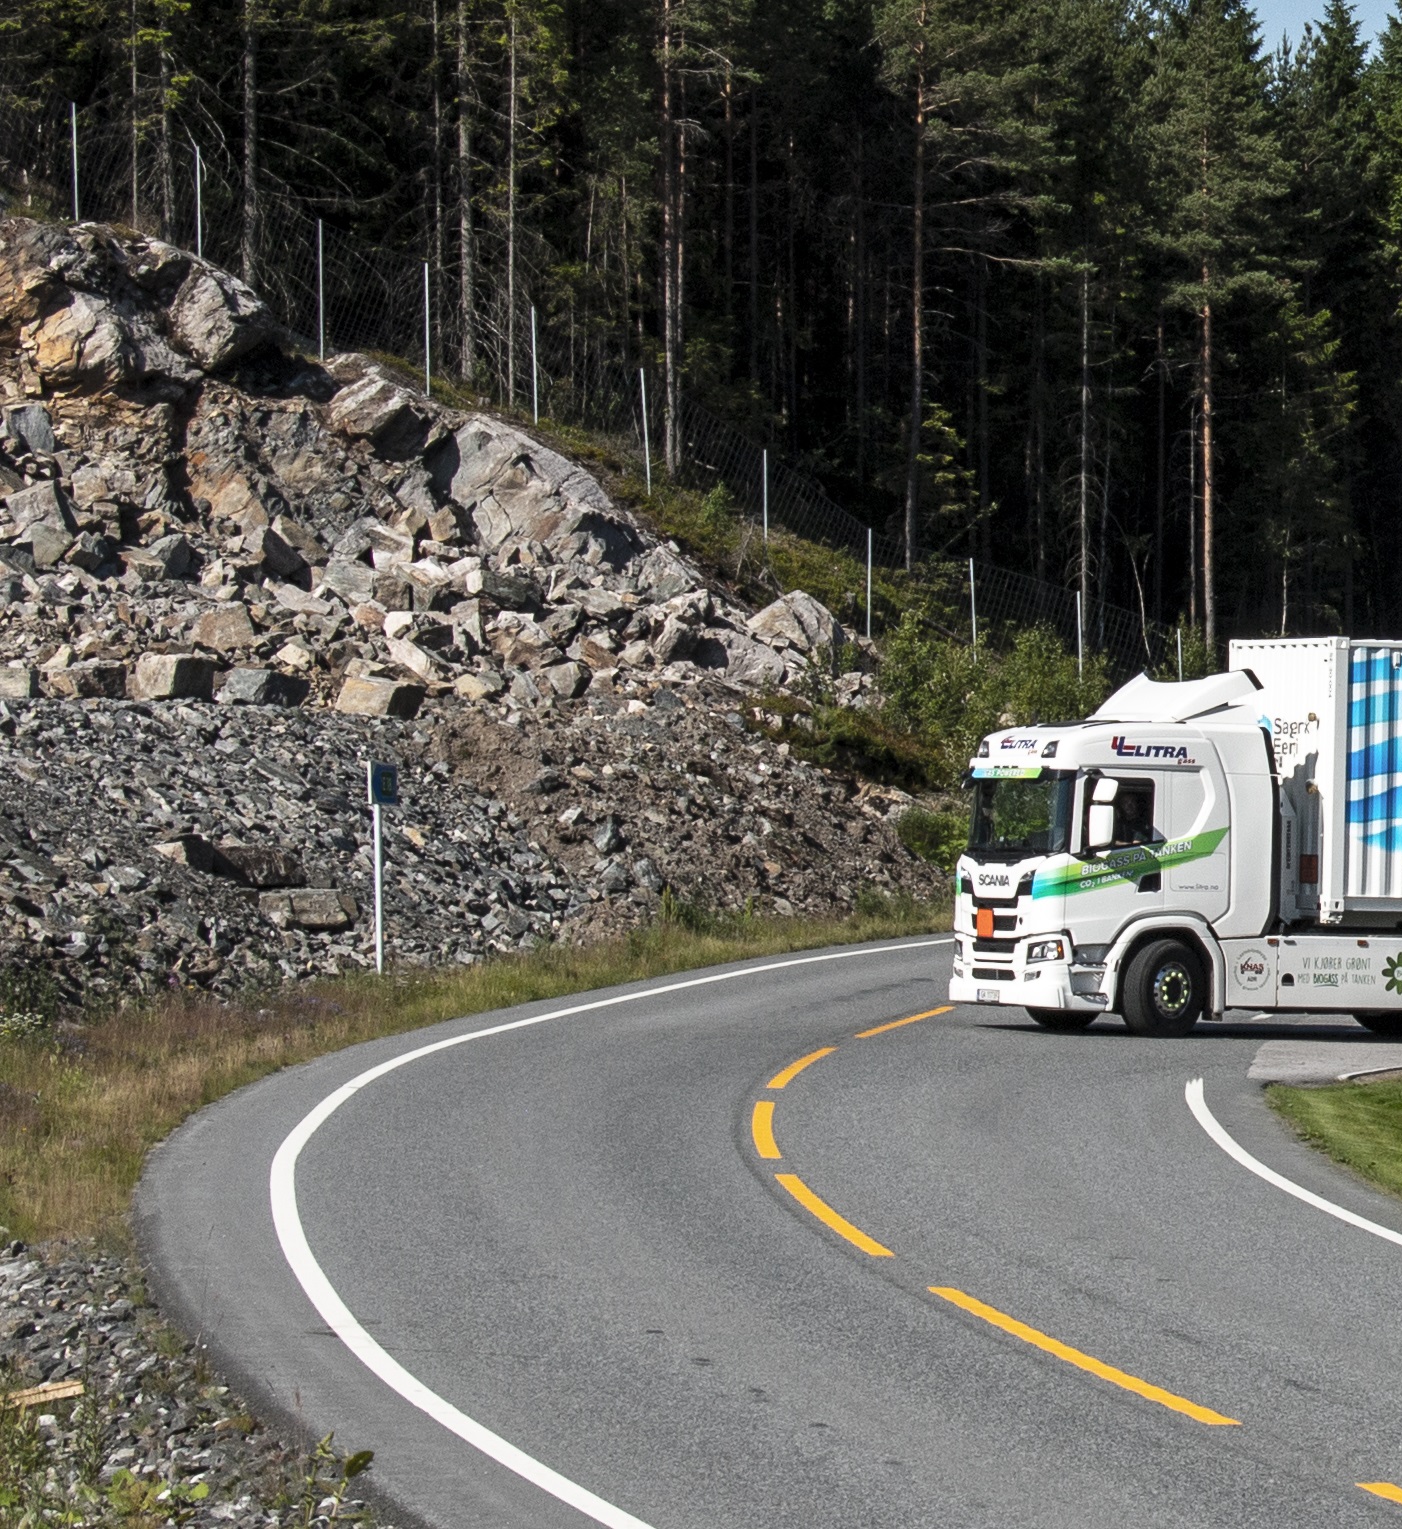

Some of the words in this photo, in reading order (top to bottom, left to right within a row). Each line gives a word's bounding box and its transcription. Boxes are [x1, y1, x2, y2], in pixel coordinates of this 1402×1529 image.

[1081, 855, 1130, 876] BIOGASS
[1133, 851, 1146, 863] PÅ
[1151, 841, 1192, 859] TANKEN
[978, 874, 1010, 886] SCANIA
[1314, 956, 1342, 970] KJØRER
[1346, 957, 1371, 970] GRØNT
[1313, 973, 1339, 984] BIOGASS
[1351, 974, 1376, 985] TANKEN
